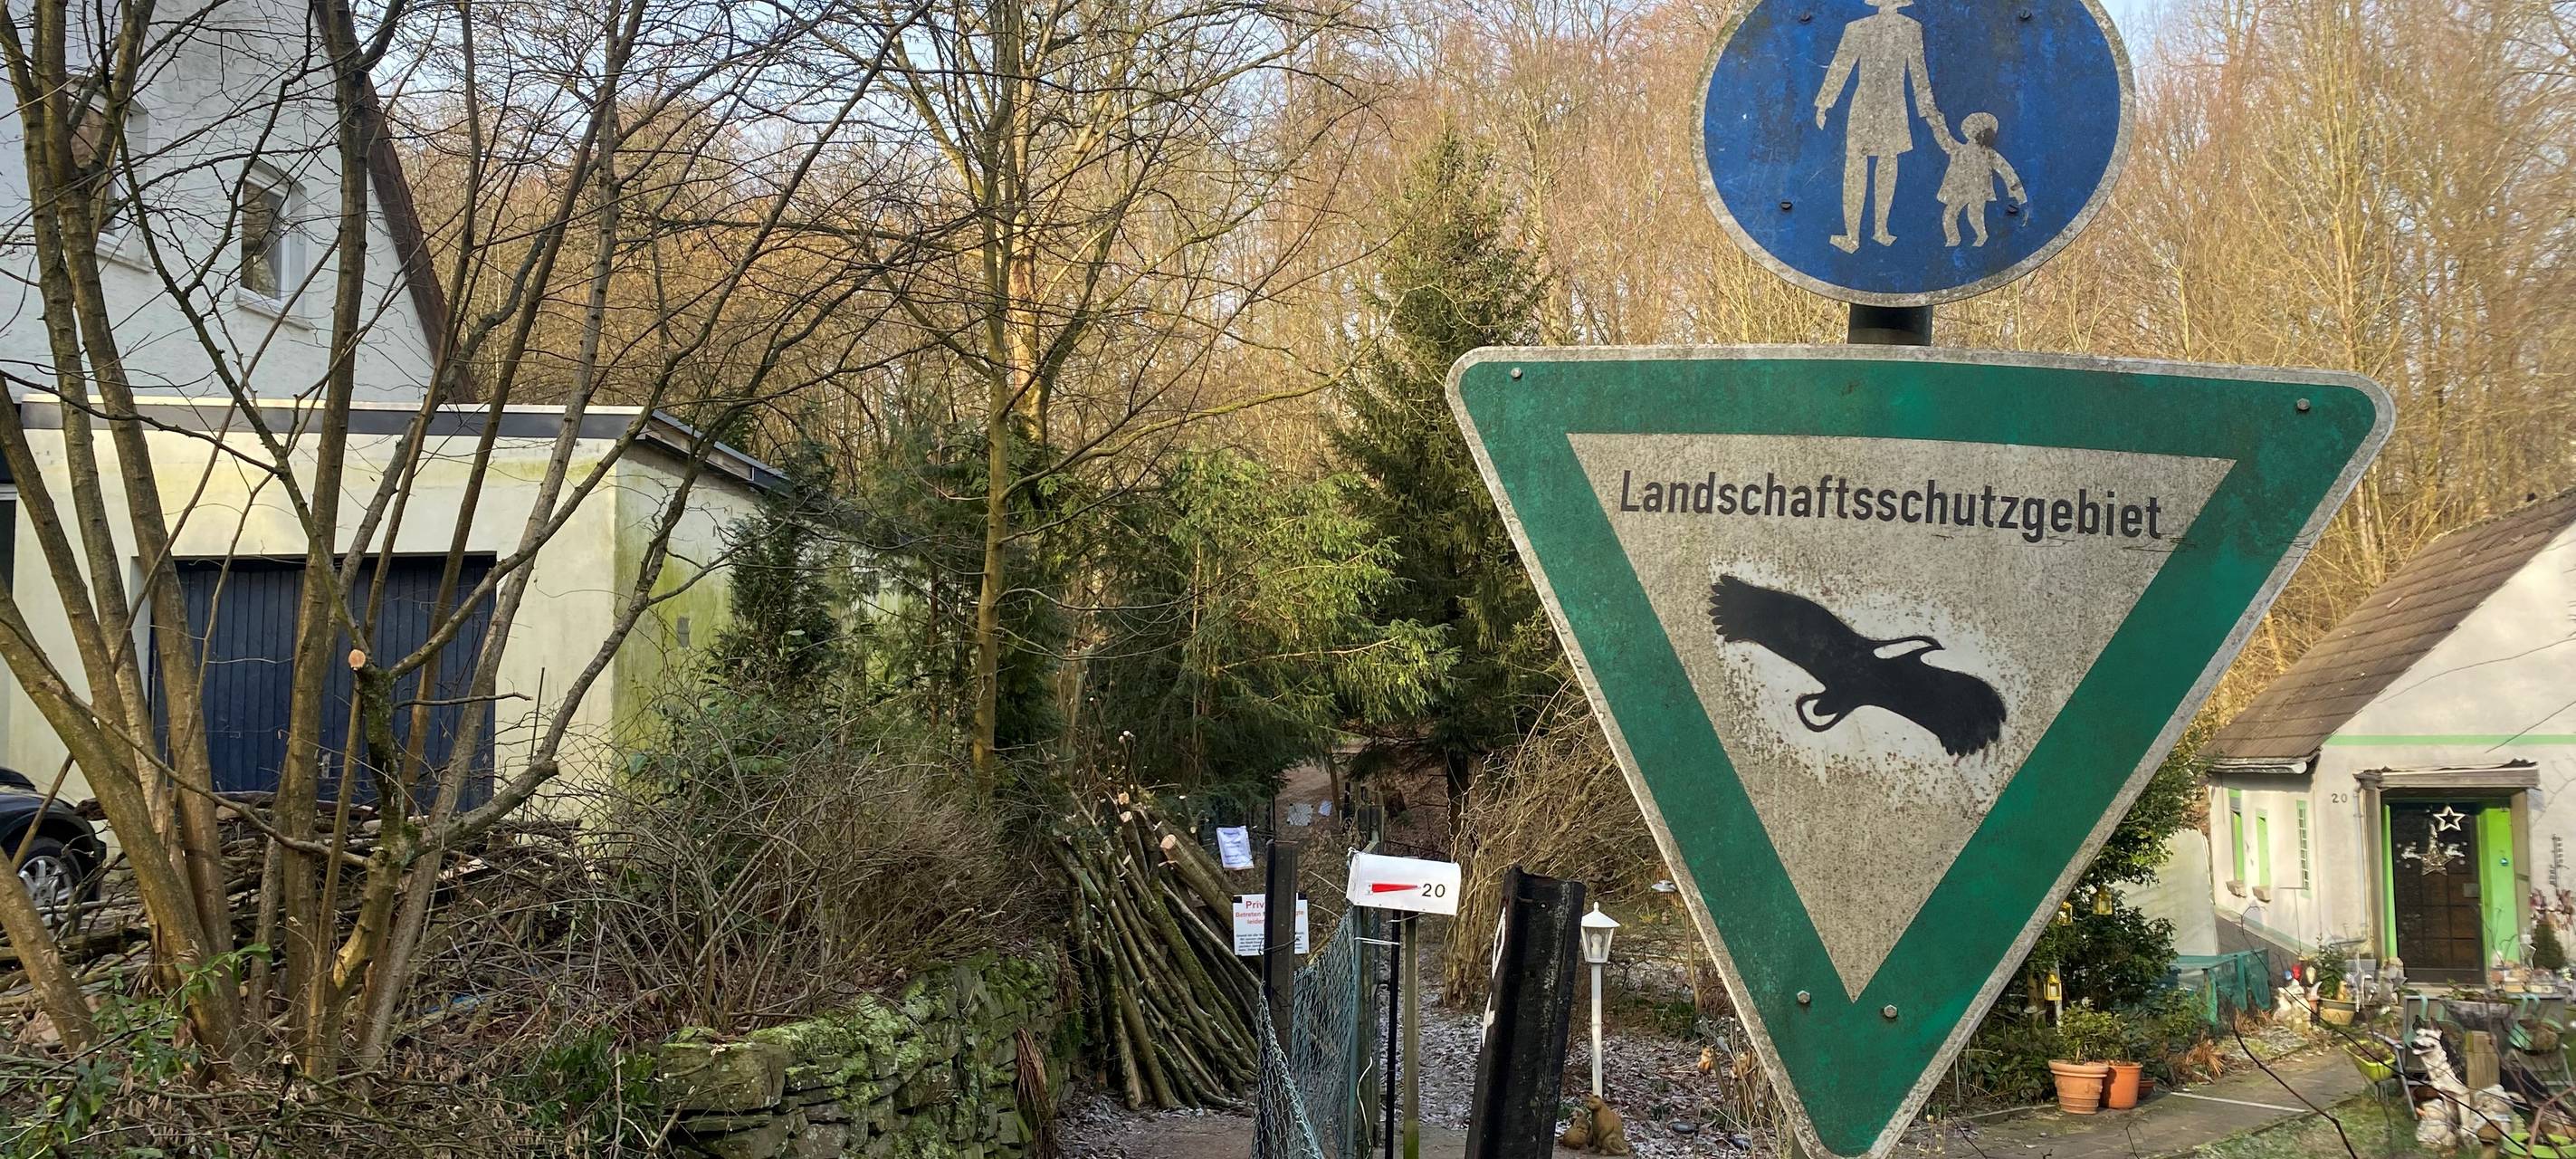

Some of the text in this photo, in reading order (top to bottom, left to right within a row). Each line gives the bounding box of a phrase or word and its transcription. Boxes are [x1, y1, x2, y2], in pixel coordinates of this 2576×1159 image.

[1620, 469, 2161, 543] Landschaftsschutzgebiet
[2331, 792, 2348, 803] 20
[1421, 883, 1445, 897] 20
[1245, 900, 1264, 909] Priv
